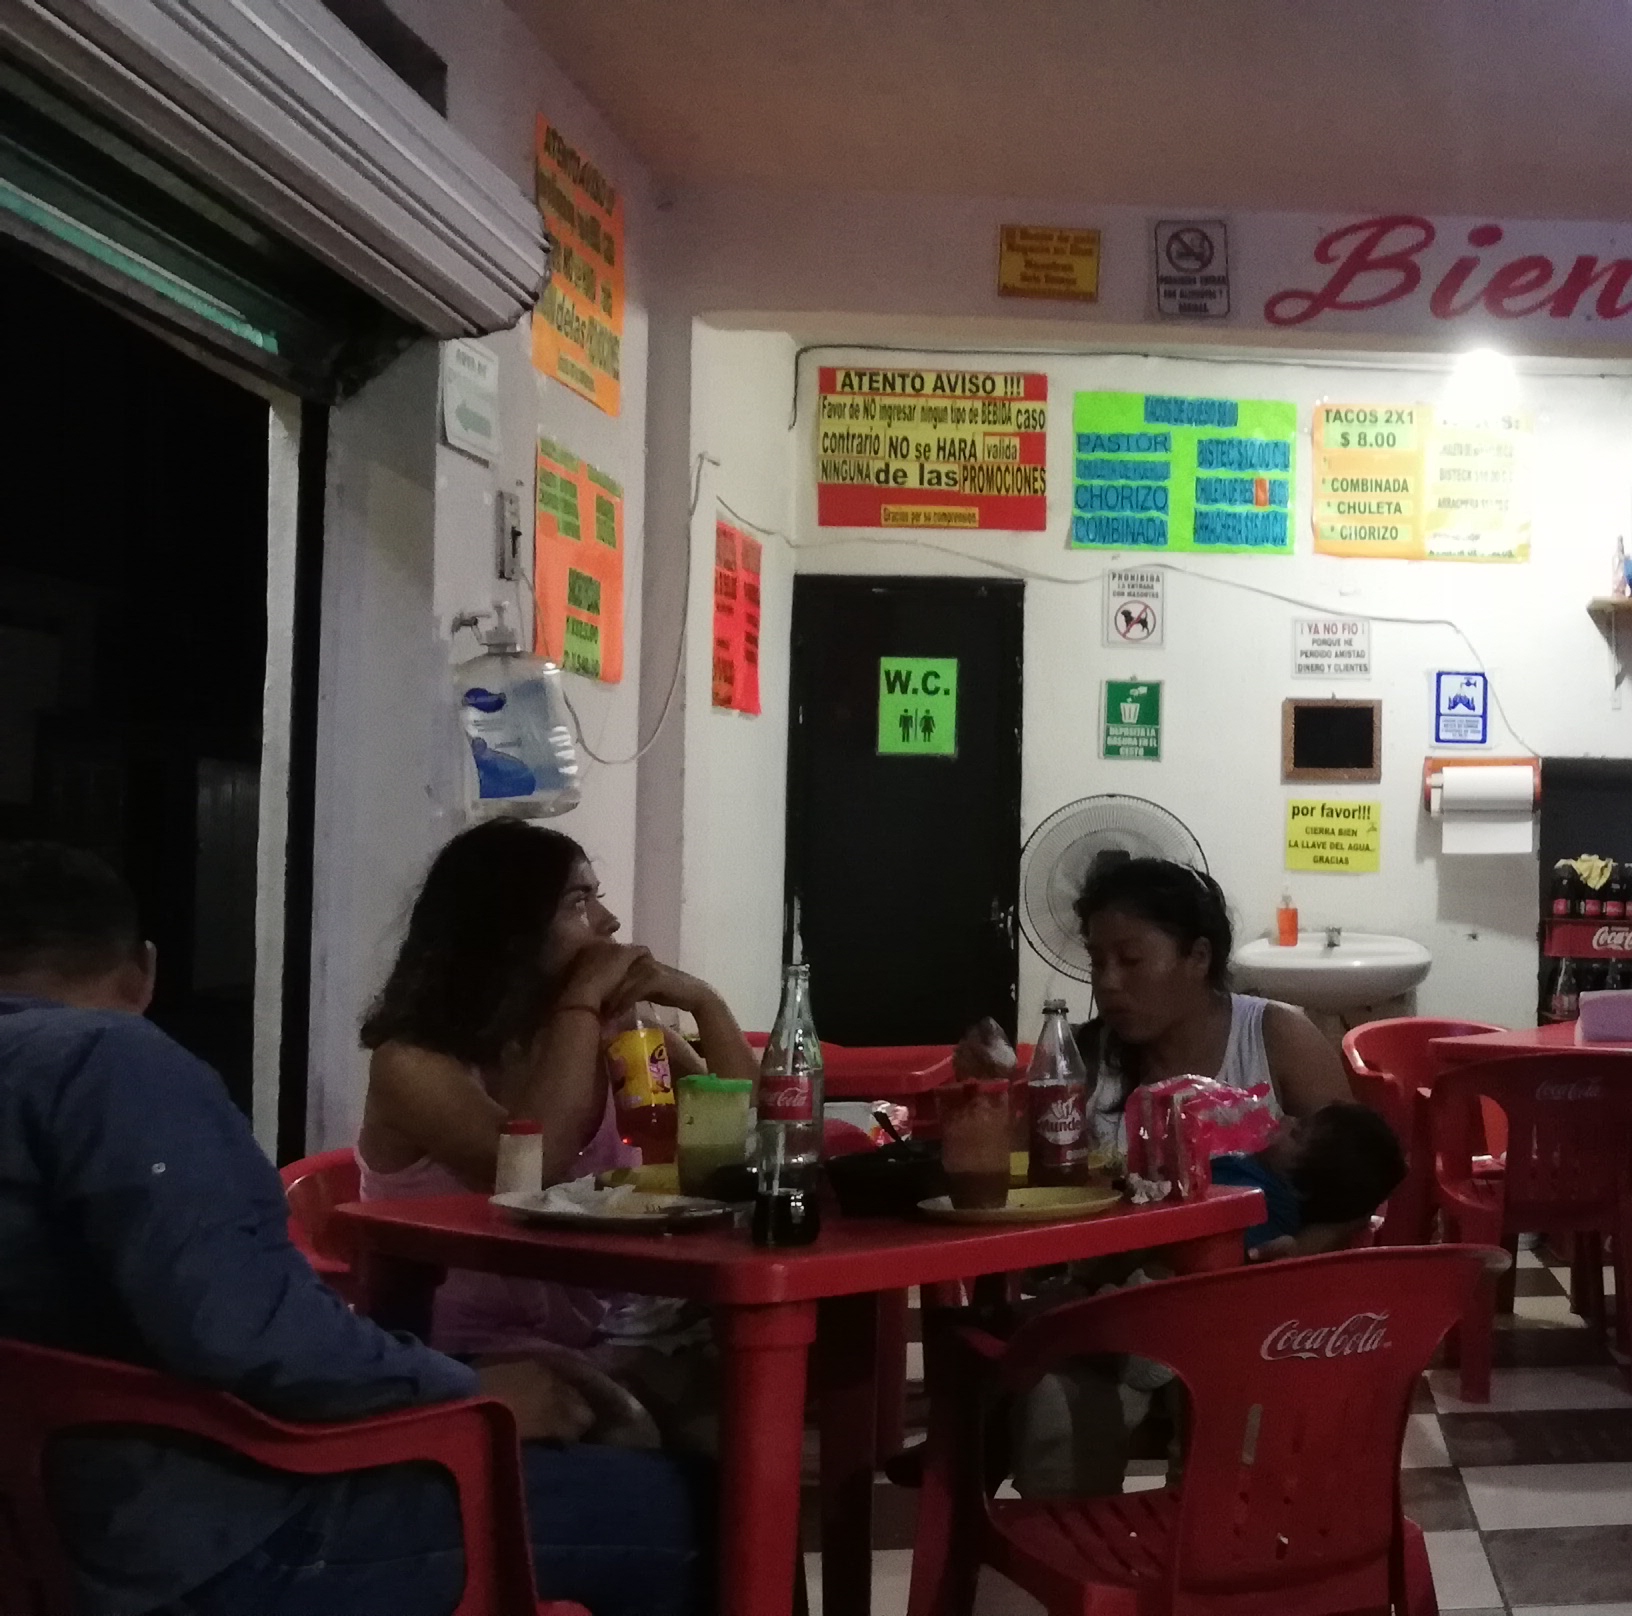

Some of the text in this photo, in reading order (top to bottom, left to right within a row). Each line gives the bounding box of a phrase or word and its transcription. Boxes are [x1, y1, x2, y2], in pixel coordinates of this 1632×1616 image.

[840, 370, 1022, 397] ATENTO AVISO !!!
[821, 396, 848, 420] Favor
[849, 399, 860, 419] de
[862, 400, 876, 419] NO
[878, 401, 916, 428] ingresar
[950, 403, 967, 429] tipo
[968, 405, 979, 424] de
[981, 404, 1013, 426] BEBIDA
[1016, 408, 1046, 430] caso
[1325, 409, 1415, 425] TACOS 2X1
[821, 426, 881, 456] contrario
[888, 435, 910, 460] NO
[914, 442, 931, 461] se
[986, 438, 1018, 460] valida
[1077, 433, 1169, 455] PASTOR
[1340, 431, 1397, 448] $ 8.00
[821, 459, 1046, 496] NINGUNA de las PROMOCIONES
[1331, 478, 1409, 493] COMBINADA
[1075, 484, 1170, 510] CHORIZO
[1337, 501, 1403, 515] CHULETA
[1075, 516, 1168, 545] COMBINADA
[1340, 525, 1399, 541] CHORIZO
[1307, 622, 1359, 635] YA NO FIO
[1312, 637, 1341, 647] PORQUE
[1300, 649, 1366, 659] PERDIDO AMISTAD
[1297, 663, 1326, 672] DINERO
[1333, 663, 1368, 672] CLIENTES
[884, 669, 950, 696] W.C.
[1291, 803, 1371, 820] por favor!!!
[1305, 826, 1357, 836] CIERRA BIEN
[1288, 840, 1299, 848] LA
[1301, 840, 1327, 849] LLAVE
[1329, 842, 1345, 850] DEL
[1313, 855, 1350, 865] GRACIAS
[1260, 1309, 1391, 1361] Coca-Cola
